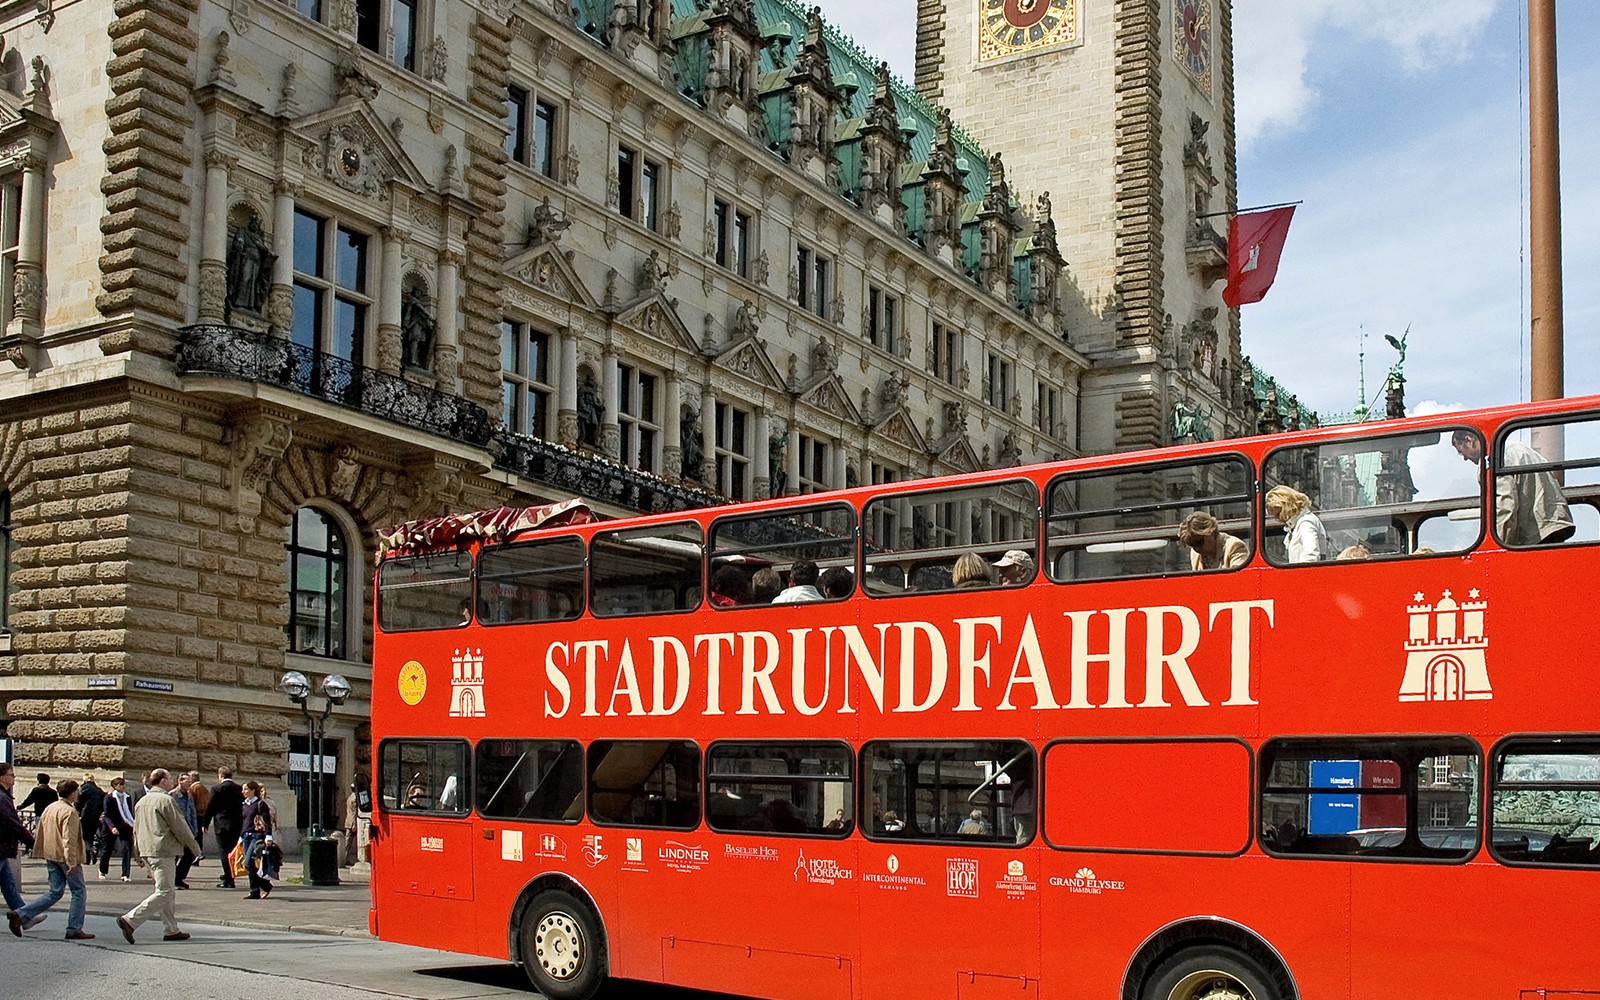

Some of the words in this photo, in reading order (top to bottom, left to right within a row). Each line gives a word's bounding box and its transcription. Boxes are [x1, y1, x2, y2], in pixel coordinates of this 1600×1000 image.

[544, 599, 1275, 719] STADTRUNDFAHRT
[658, 847, 710, 861] LINDNER
[810, 859, 839, 869] HOTEL
[810, 868, 852, 879] VORBACH
[949, 870, 976, 890] HOF
[1049, 877, 1084, 887] GRAND
[1086, 880, 1125, 890] ELYSEE
